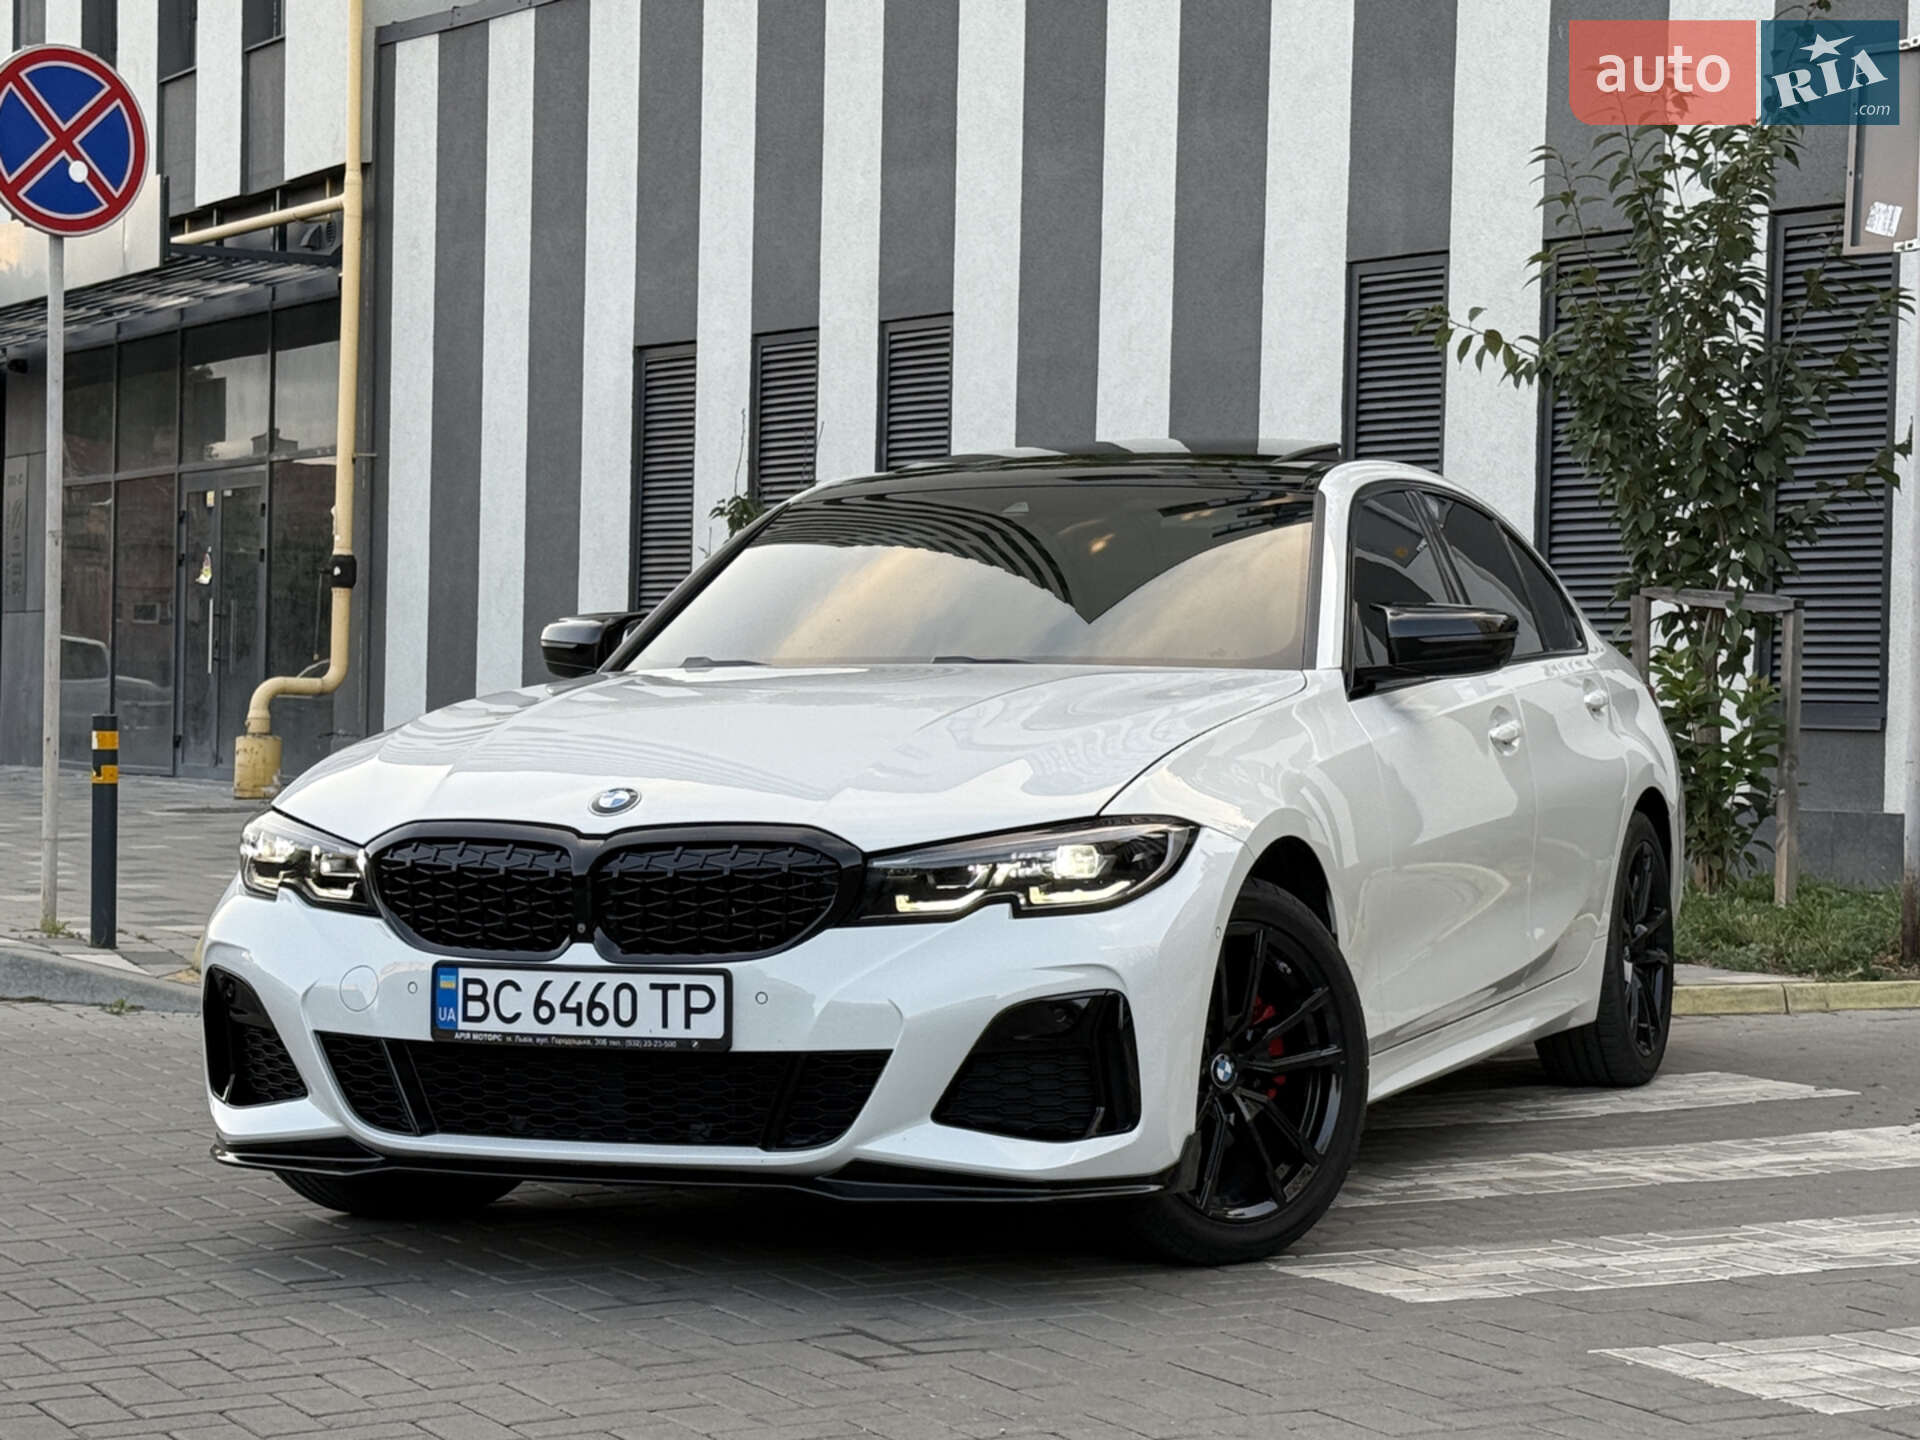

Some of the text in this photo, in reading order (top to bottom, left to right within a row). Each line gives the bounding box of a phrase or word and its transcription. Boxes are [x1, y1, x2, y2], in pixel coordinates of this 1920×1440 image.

[461, 976, 717, 1030] BC 6460 TP
[437, 1006, 456, 1023] UA
[472, 1032, 503, 1042] МОТОРС
